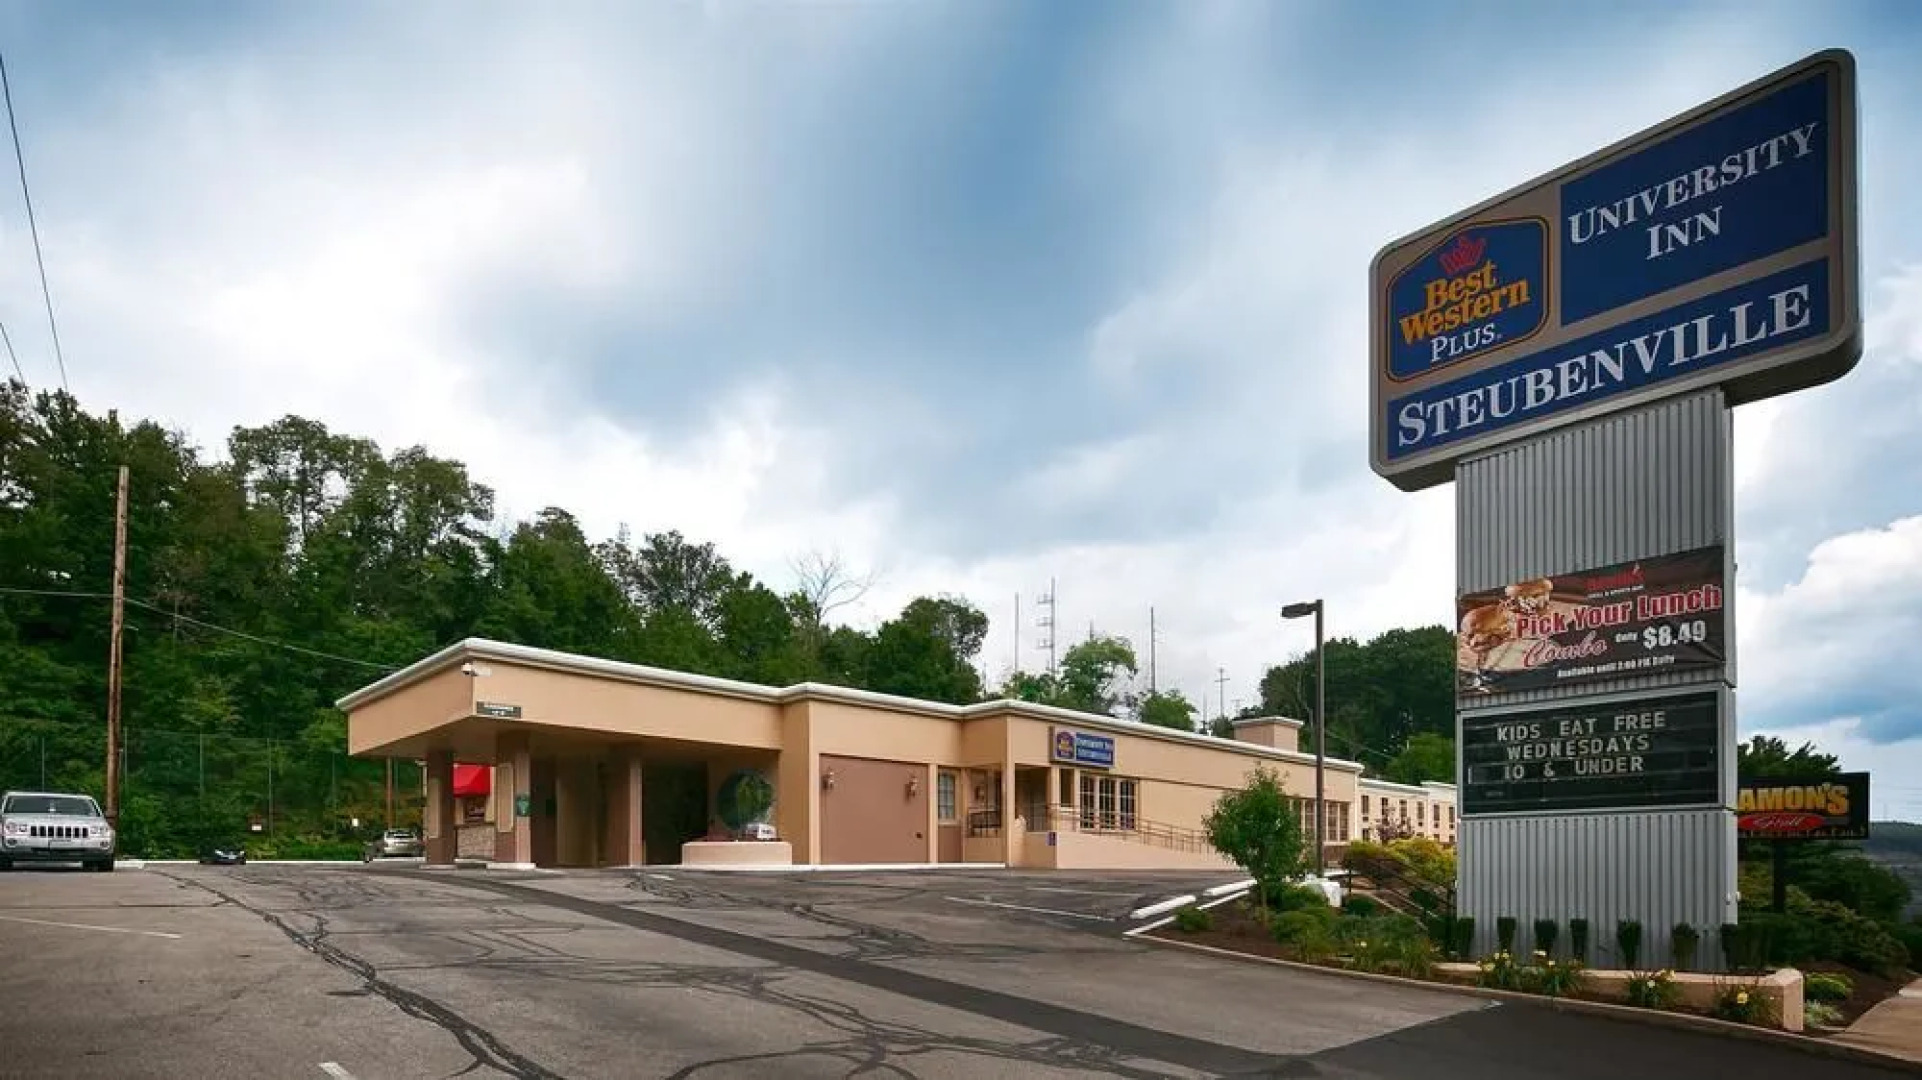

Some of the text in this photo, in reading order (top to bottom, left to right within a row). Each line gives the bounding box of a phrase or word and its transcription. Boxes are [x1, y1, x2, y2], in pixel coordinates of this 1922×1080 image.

[1568, 122, 1817, 244] UNIVERSITY
[1646, 206, 1722, 260] INN
[1424, 259, 1497, 310] Best
[1399, 278, 1530, 345] Western
[1430, 322, 1496, 362] PLUS
[1399, 284, 1811, 446] STEUBENVILLE
[1514, 610, 1569, 640] Pick
[1571, 601, 1633, 631] Your
[1637, 584, 1722, 621] Lunch
[1643, 620, 1706, 650] $8.49
[1496, 711, 1666, 741] KIDS EAT FREE
[1507, 734, 1650, 760] WEDNESDAYS
[1543, 762, 1555, 777] &
[1575, 756, 1644, 775] UNDER
[1738, 783, 1849, 815] AMON'S
